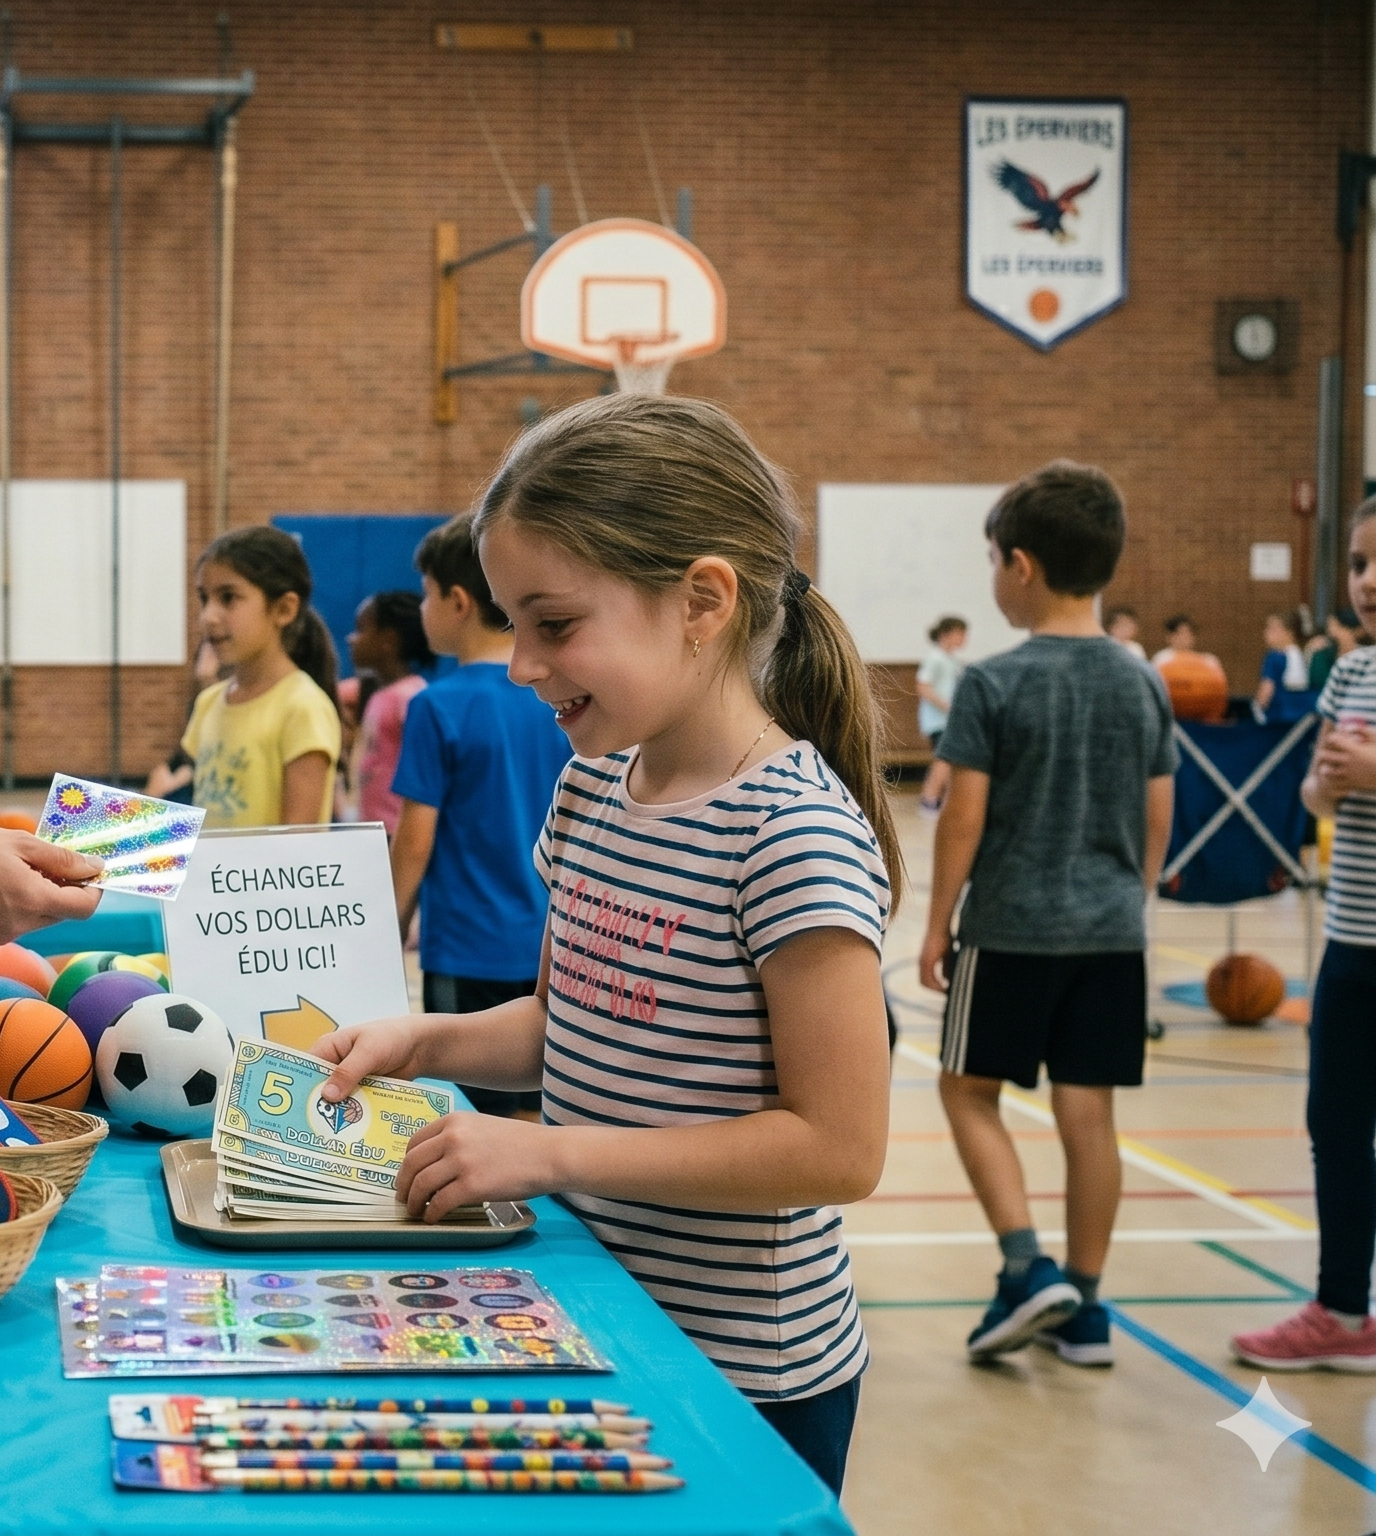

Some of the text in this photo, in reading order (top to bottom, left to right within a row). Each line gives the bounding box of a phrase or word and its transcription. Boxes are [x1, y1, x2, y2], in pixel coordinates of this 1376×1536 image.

[976, 116, 1007, 148] LES
[982, 255, 1009, 275] LES
[210, 863, 345, 894] ÉCHANGEZ
[195, 902, 366, 936] VOS DOLLARS
[237, 943, 337, 975] ÉDU ICI!
[258, 1070, 295, 1117] 5
[350, 1138, 385, 1160] ÉDU
